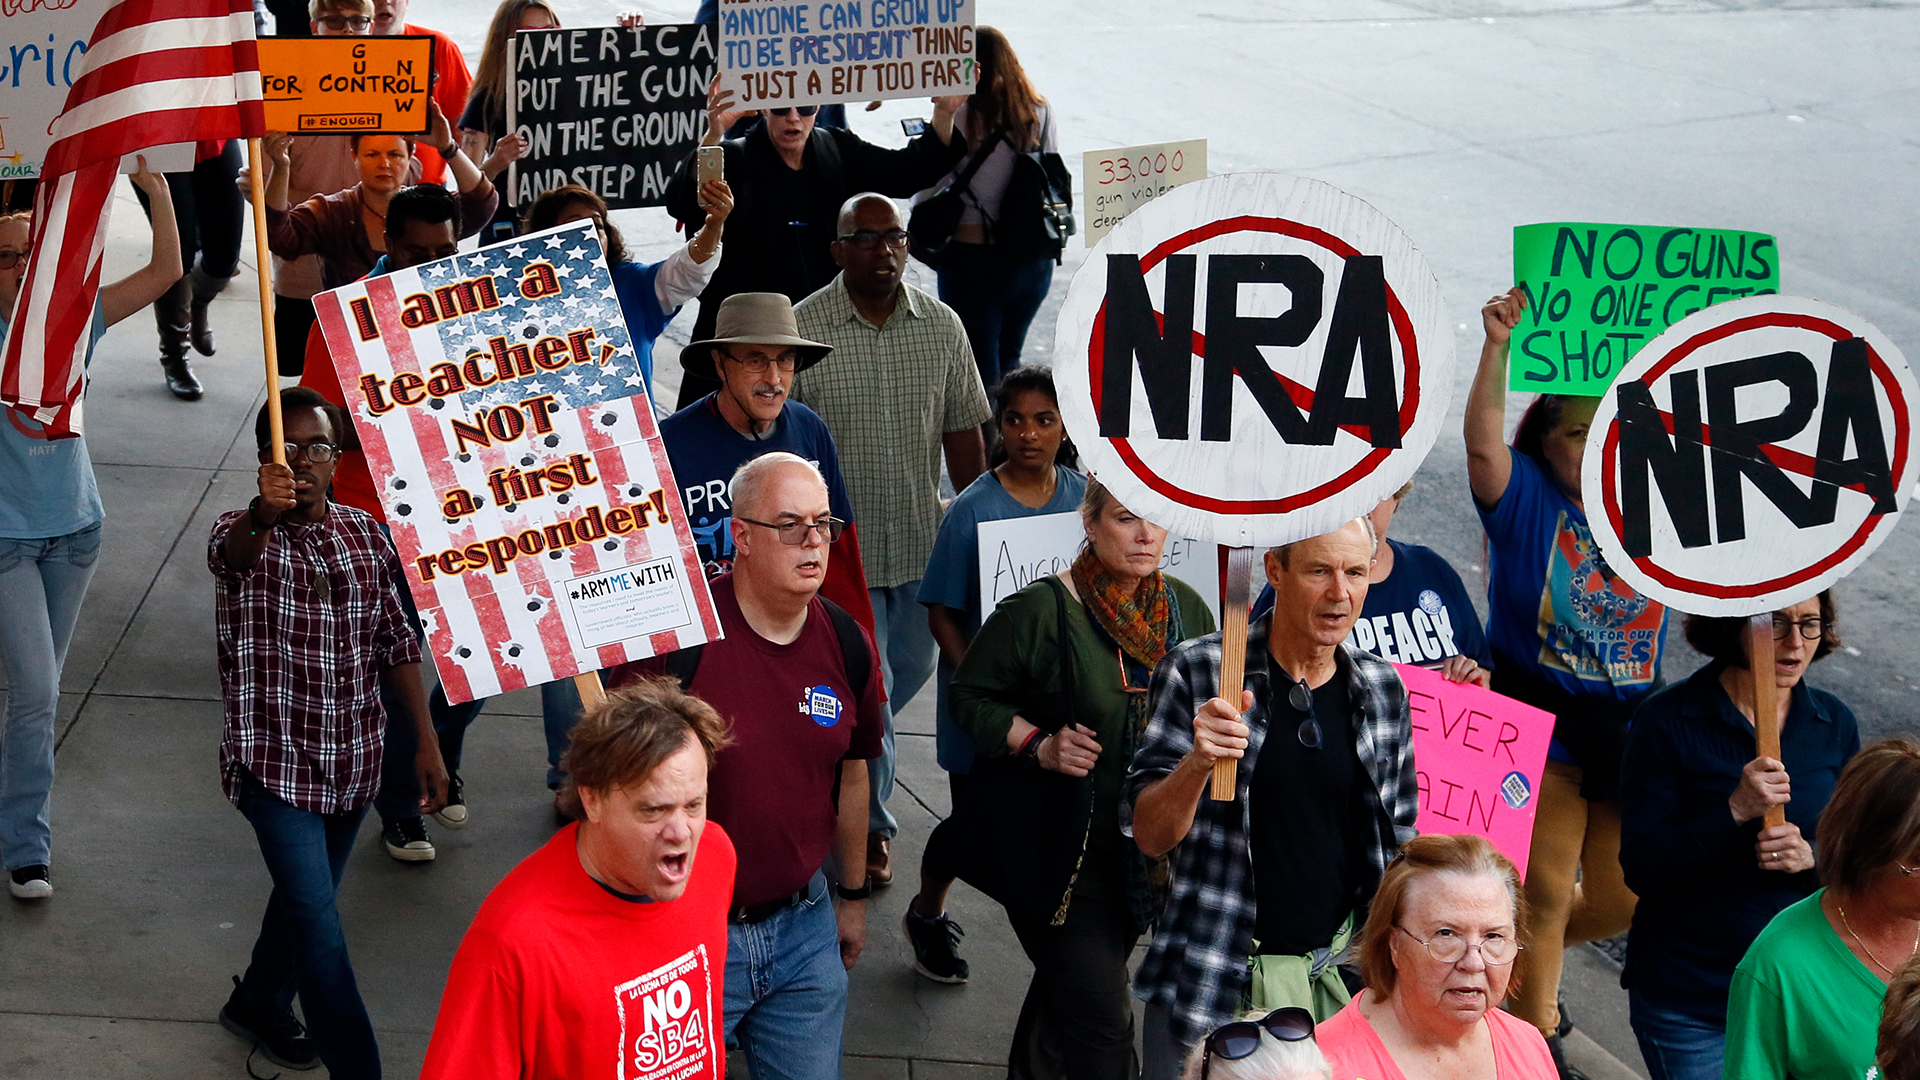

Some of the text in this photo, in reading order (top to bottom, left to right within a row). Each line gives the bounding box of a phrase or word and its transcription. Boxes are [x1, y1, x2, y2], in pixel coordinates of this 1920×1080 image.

[819, 1, 862, 31] CAN
[871, 0, 929, 28] GROW
[937, 0, 965, 23] UP
[517, 24, 718, 72] AMERICA,
[724, 40, 752, 69] TO
[757, 37, 784, 67] BE
[912, 25, 973, 55] THING
[263, 74, 424, 94] FOR CONTROL
[517, 77, 561, 112] PUT
[575, 71, 631, 108] THE
[741, 57, 974, 102] JUST A BIT TOO FAR?
[516, 108, 711, 160] ON THE GROUND
[2, 165, 35, 177] OUR
[518, 168, 568, 205] AND
[571, 163, 635, 200] STEP
[1098, 150, 1184, 185] 33,000
[1095, 179, 1175, 212] gun violen
[1550, 227, 1773, 280] NO GUNS
[349, 261, 561, 343] I am a
[1519, 281, 1571, 327] NO
[1591, 283, 1658, 328] ONE
[360, 326, 616, 414] teacher,
[1099, 254, 1402, 449] NRA
[451, 394, 555, 454] NOT
[1617, 337, 1898, 558] NRA
[443, 453, 599, 520] a first
[685, 479, 733, 516] PR
[415, 489, 671, 583] responder!
[1346, 606, 1459, 664] PEACH
[1599, 630, 1625, 640] FOR
[1409, 690, 1519, 765] EVER
[1416, 771, 1497, 832] AIN
[629, 958, 698, 1000] LA LUCHA ES DE TODOS
[642, 979, 691, 1034] NO
[634, 1008, 704, 1072] SB4
